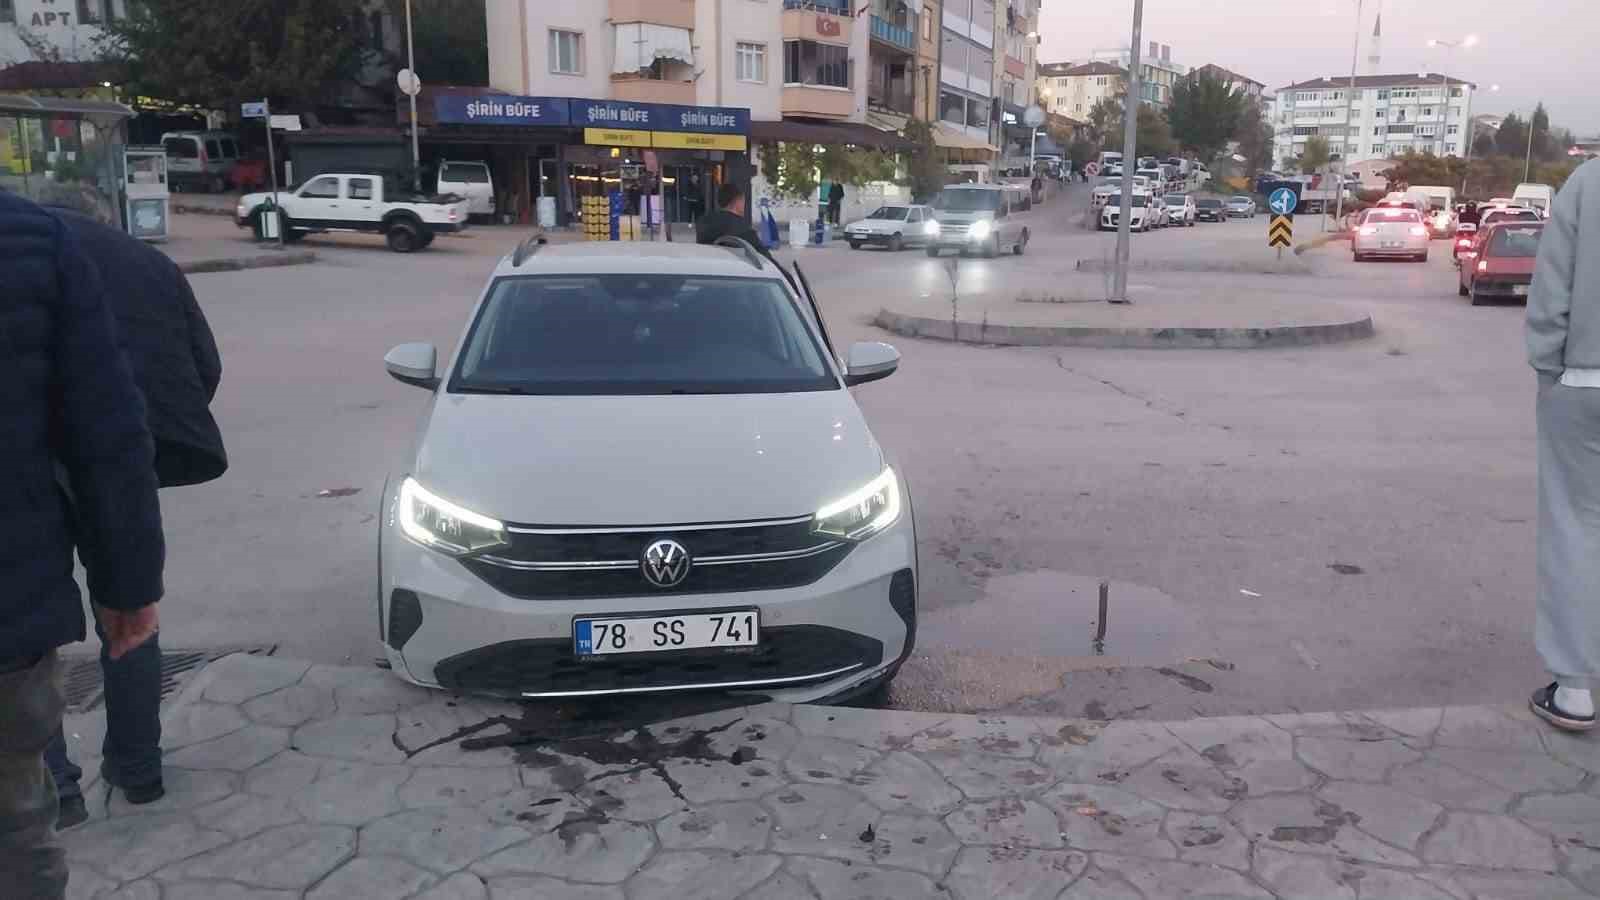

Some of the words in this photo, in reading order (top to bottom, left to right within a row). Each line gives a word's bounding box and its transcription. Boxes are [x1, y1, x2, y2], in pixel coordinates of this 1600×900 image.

[31, 11, 71, 27] APT
[466, 100, 503, 119] ŞİRİN
[505, 102, 541, 118] BÜFE
[587, 104, 618, 123] ŞİRİN
[620, 107, 649, 123] BÜFE
[680, 111, 708, 127] ŞİRİN
[710, 112, 736, 127] BÜFE
[594, 623, 627, 650] 78
[652, 619, 686, 647] SS
[709, 615, 753, 643] 741
